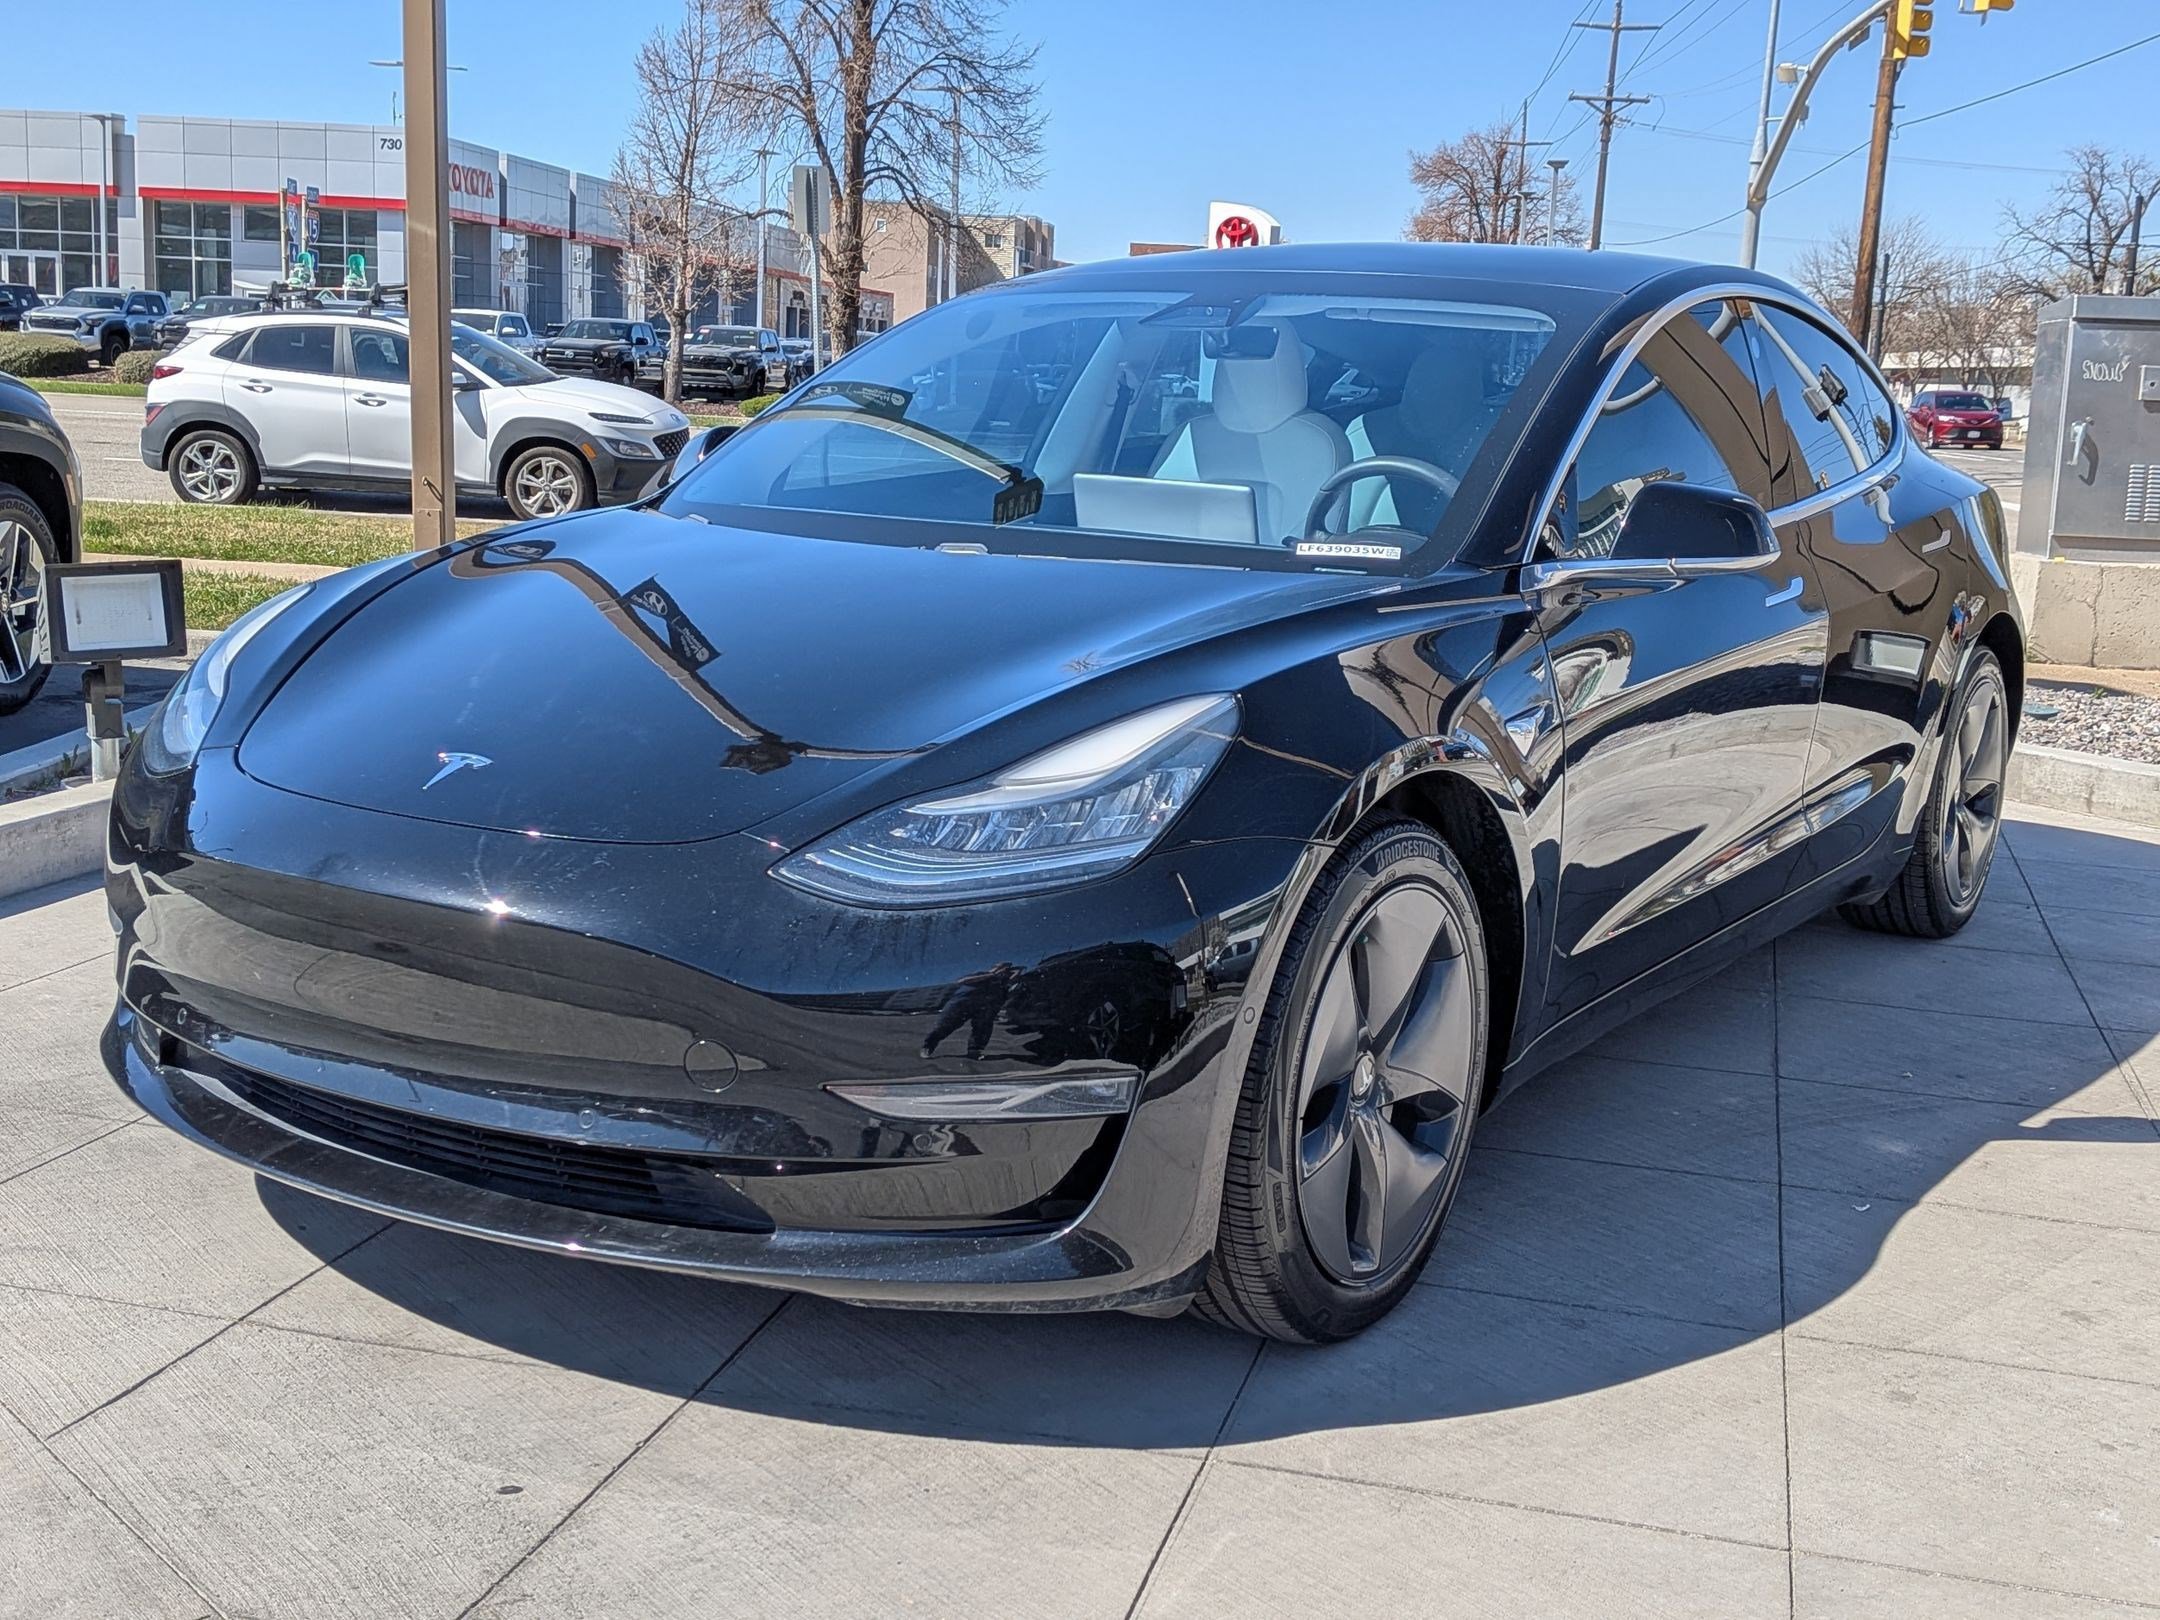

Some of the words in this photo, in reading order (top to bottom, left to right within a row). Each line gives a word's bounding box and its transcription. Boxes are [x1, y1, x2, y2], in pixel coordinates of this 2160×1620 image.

[379, 138, 403, 150] 730
[447, 163, 495, 200] OYOTA
[308, 219, 318, 239] 15
[1299, 544, 1385, 555] LF639035W
[1375, 839, 1441, 873] BRIDGESTONE
